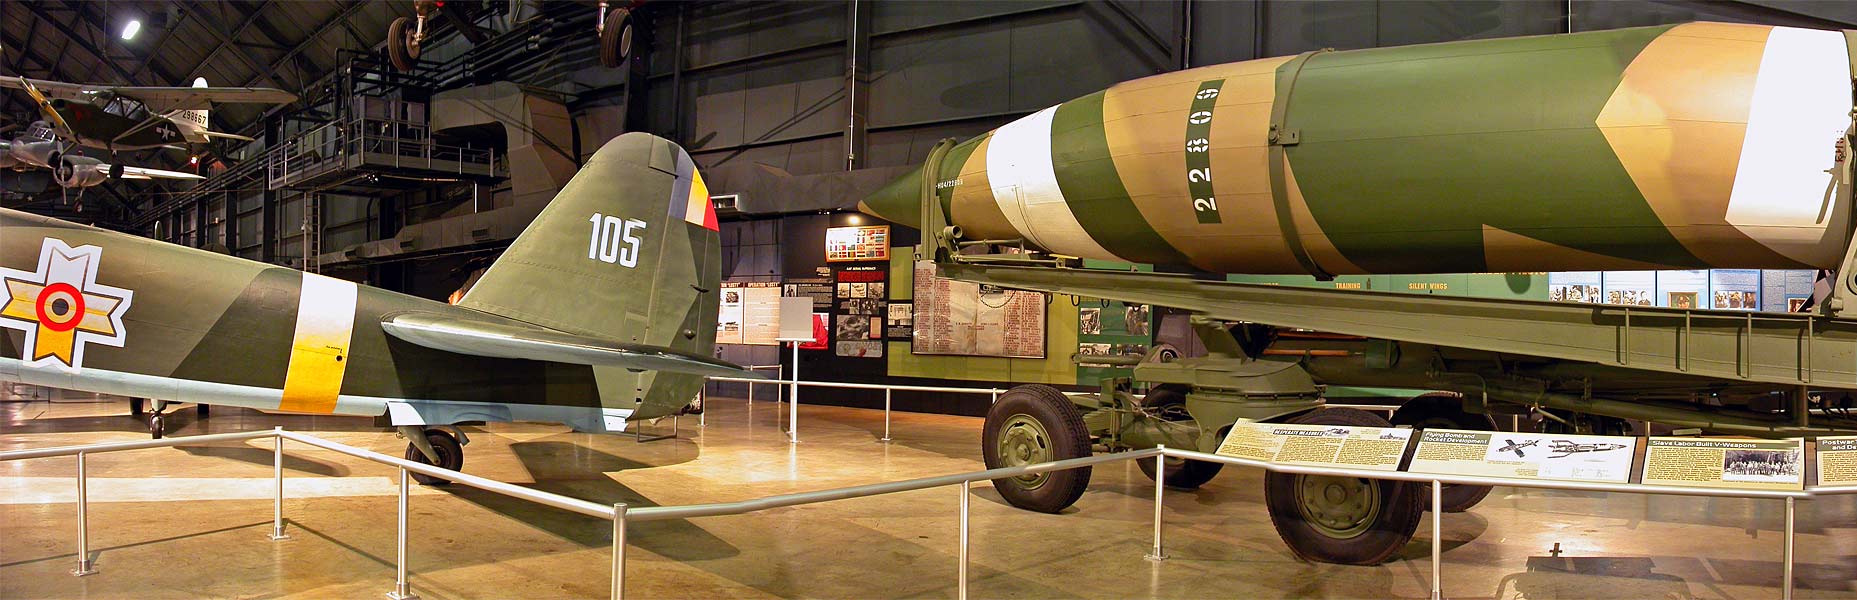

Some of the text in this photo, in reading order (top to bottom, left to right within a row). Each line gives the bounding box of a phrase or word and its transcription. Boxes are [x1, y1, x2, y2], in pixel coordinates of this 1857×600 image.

[1186, 88, 1219, 212] 22809
[589, 212, 647, 268] 105
[1408, 282, 1448, 290] SILENT WINGS
[1715, 441, 1757, 449] V-Weapons
